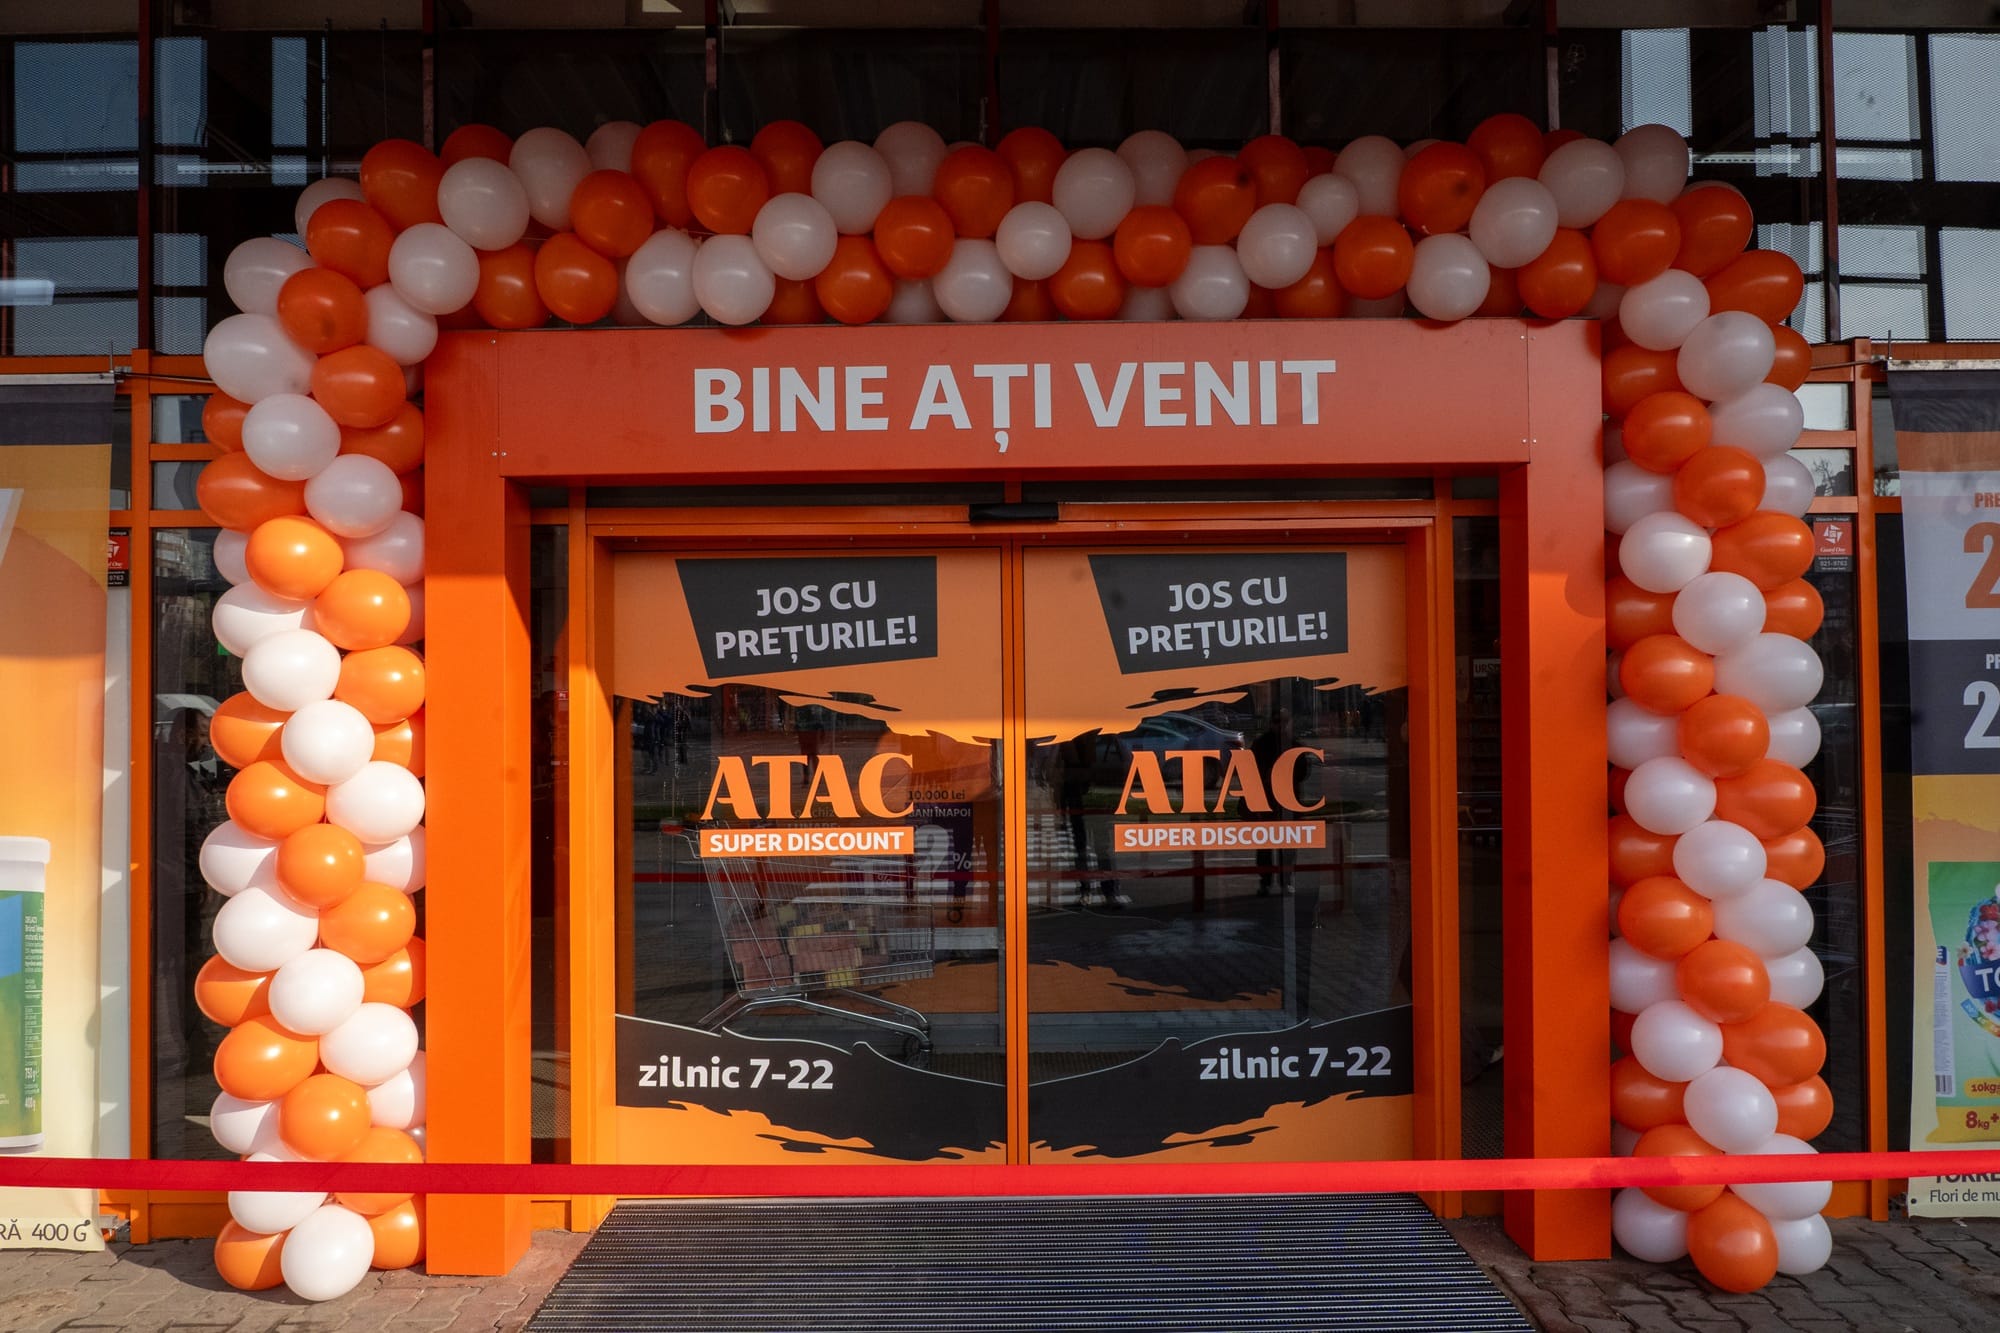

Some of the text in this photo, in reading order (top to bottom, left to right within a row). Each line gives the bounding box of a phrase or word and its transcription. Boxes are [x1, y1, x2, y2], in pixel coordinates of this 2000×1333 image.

[693, 359, 1337, 453] BINE AȚI VENIT
[1963, 521, 2000, 609] 2
[756, 580, 877, 617] JOS CU
[1168, 576, 1288, 613] JOS CU
[715, 615, 918, 664] PREȚURILE!
[1128, 611, 1328, 659] PREȚURILE!
[1963, 680, 2000, 749] 2
[700, 752, 914, 820] ATAC
[1114, 747, 1326, 815] ATAC
[934, 806, 971, 818] ÎNAPOI
[710, 832, 904, 852] SUPER DISCOUNT
[1124, 825, 1316, 847] SUPER DISCOUNT
[638, 1055, 834, 1090] zilnic 7-22
[1200, 1045, 1392, 1080] zilnic 7-22
[1930, 1188, 1959, 1203] Flori
[1962, 1188, 1979, 1202] de
[31, 1223, 69, 1241] 400
[73, 1223, 88, 1242] G
